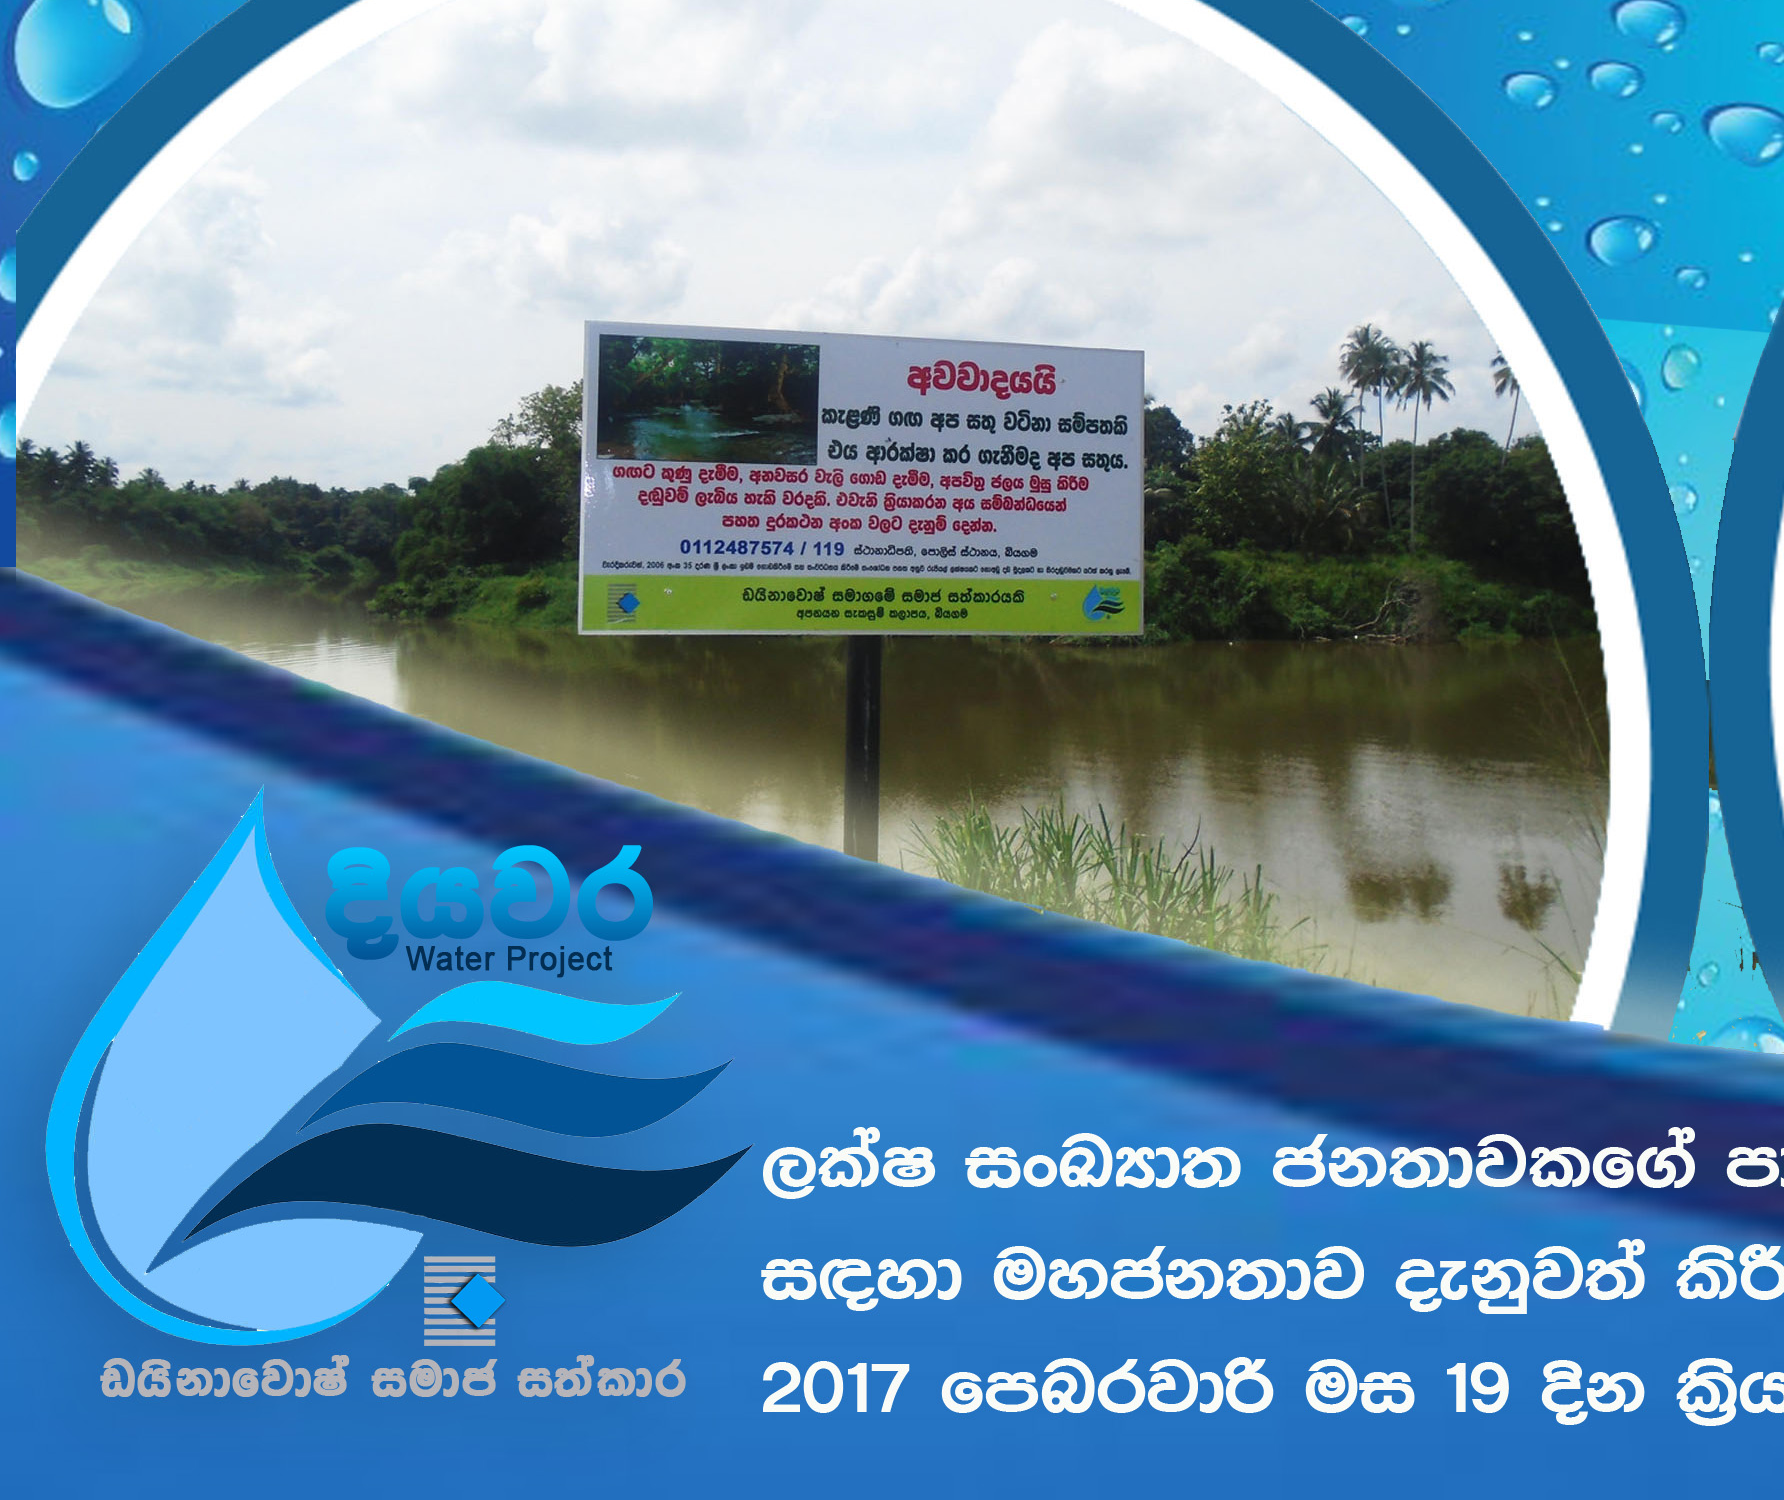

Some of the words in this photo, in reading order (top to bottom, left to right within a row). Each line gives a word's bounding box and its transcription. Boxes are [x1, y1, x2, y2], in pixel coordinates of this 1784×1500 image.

[908, 360, 1056, 400] අවවාදයයි
[822, 406, 880, 429] කැළණි
[889, 411, 923, 427] ගඟ
[931, 413, 959, 432] අප
[966, 414, 996, 434] සතු
[1004, 409, 1051, 432] වටිනා
[1058, 412, 1128, 435] සම්පතකි
[680, 539, 794, 555] 0112487574
[814, 542, 844, 556] 119
